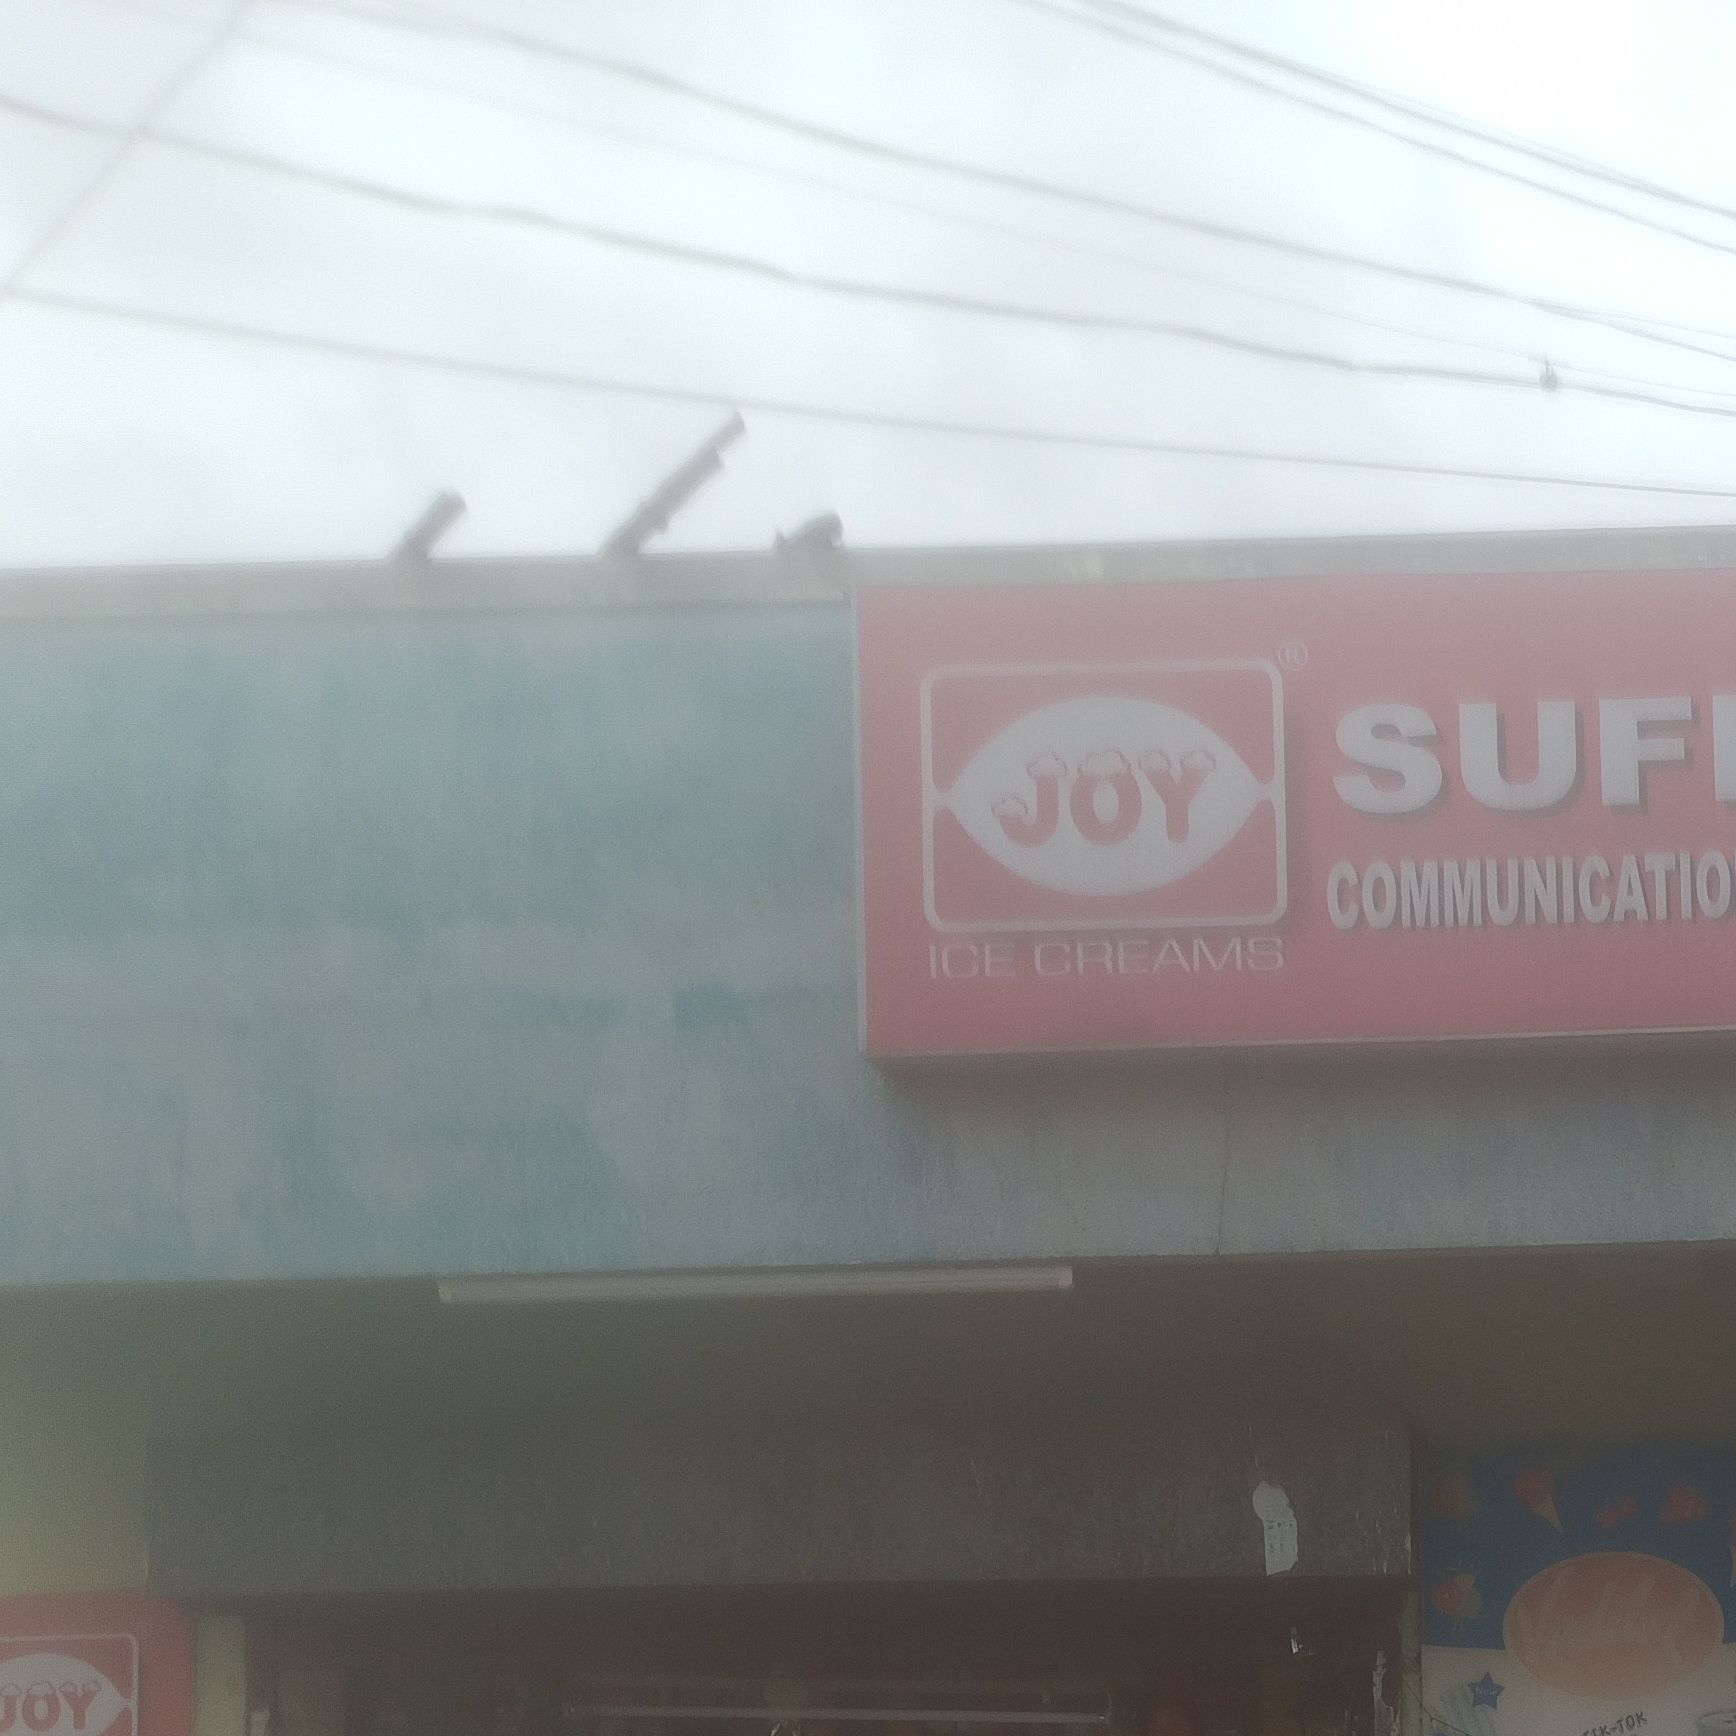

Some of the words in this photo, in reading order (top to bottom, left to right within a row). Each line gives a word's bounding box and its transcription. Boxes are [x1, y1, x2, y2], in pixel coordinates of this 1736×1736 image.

[991, 747, 1217, 847] JOY
[929, 943, 1017, 979] ICE
[1034, 936, 1285, 976] CREAMS
